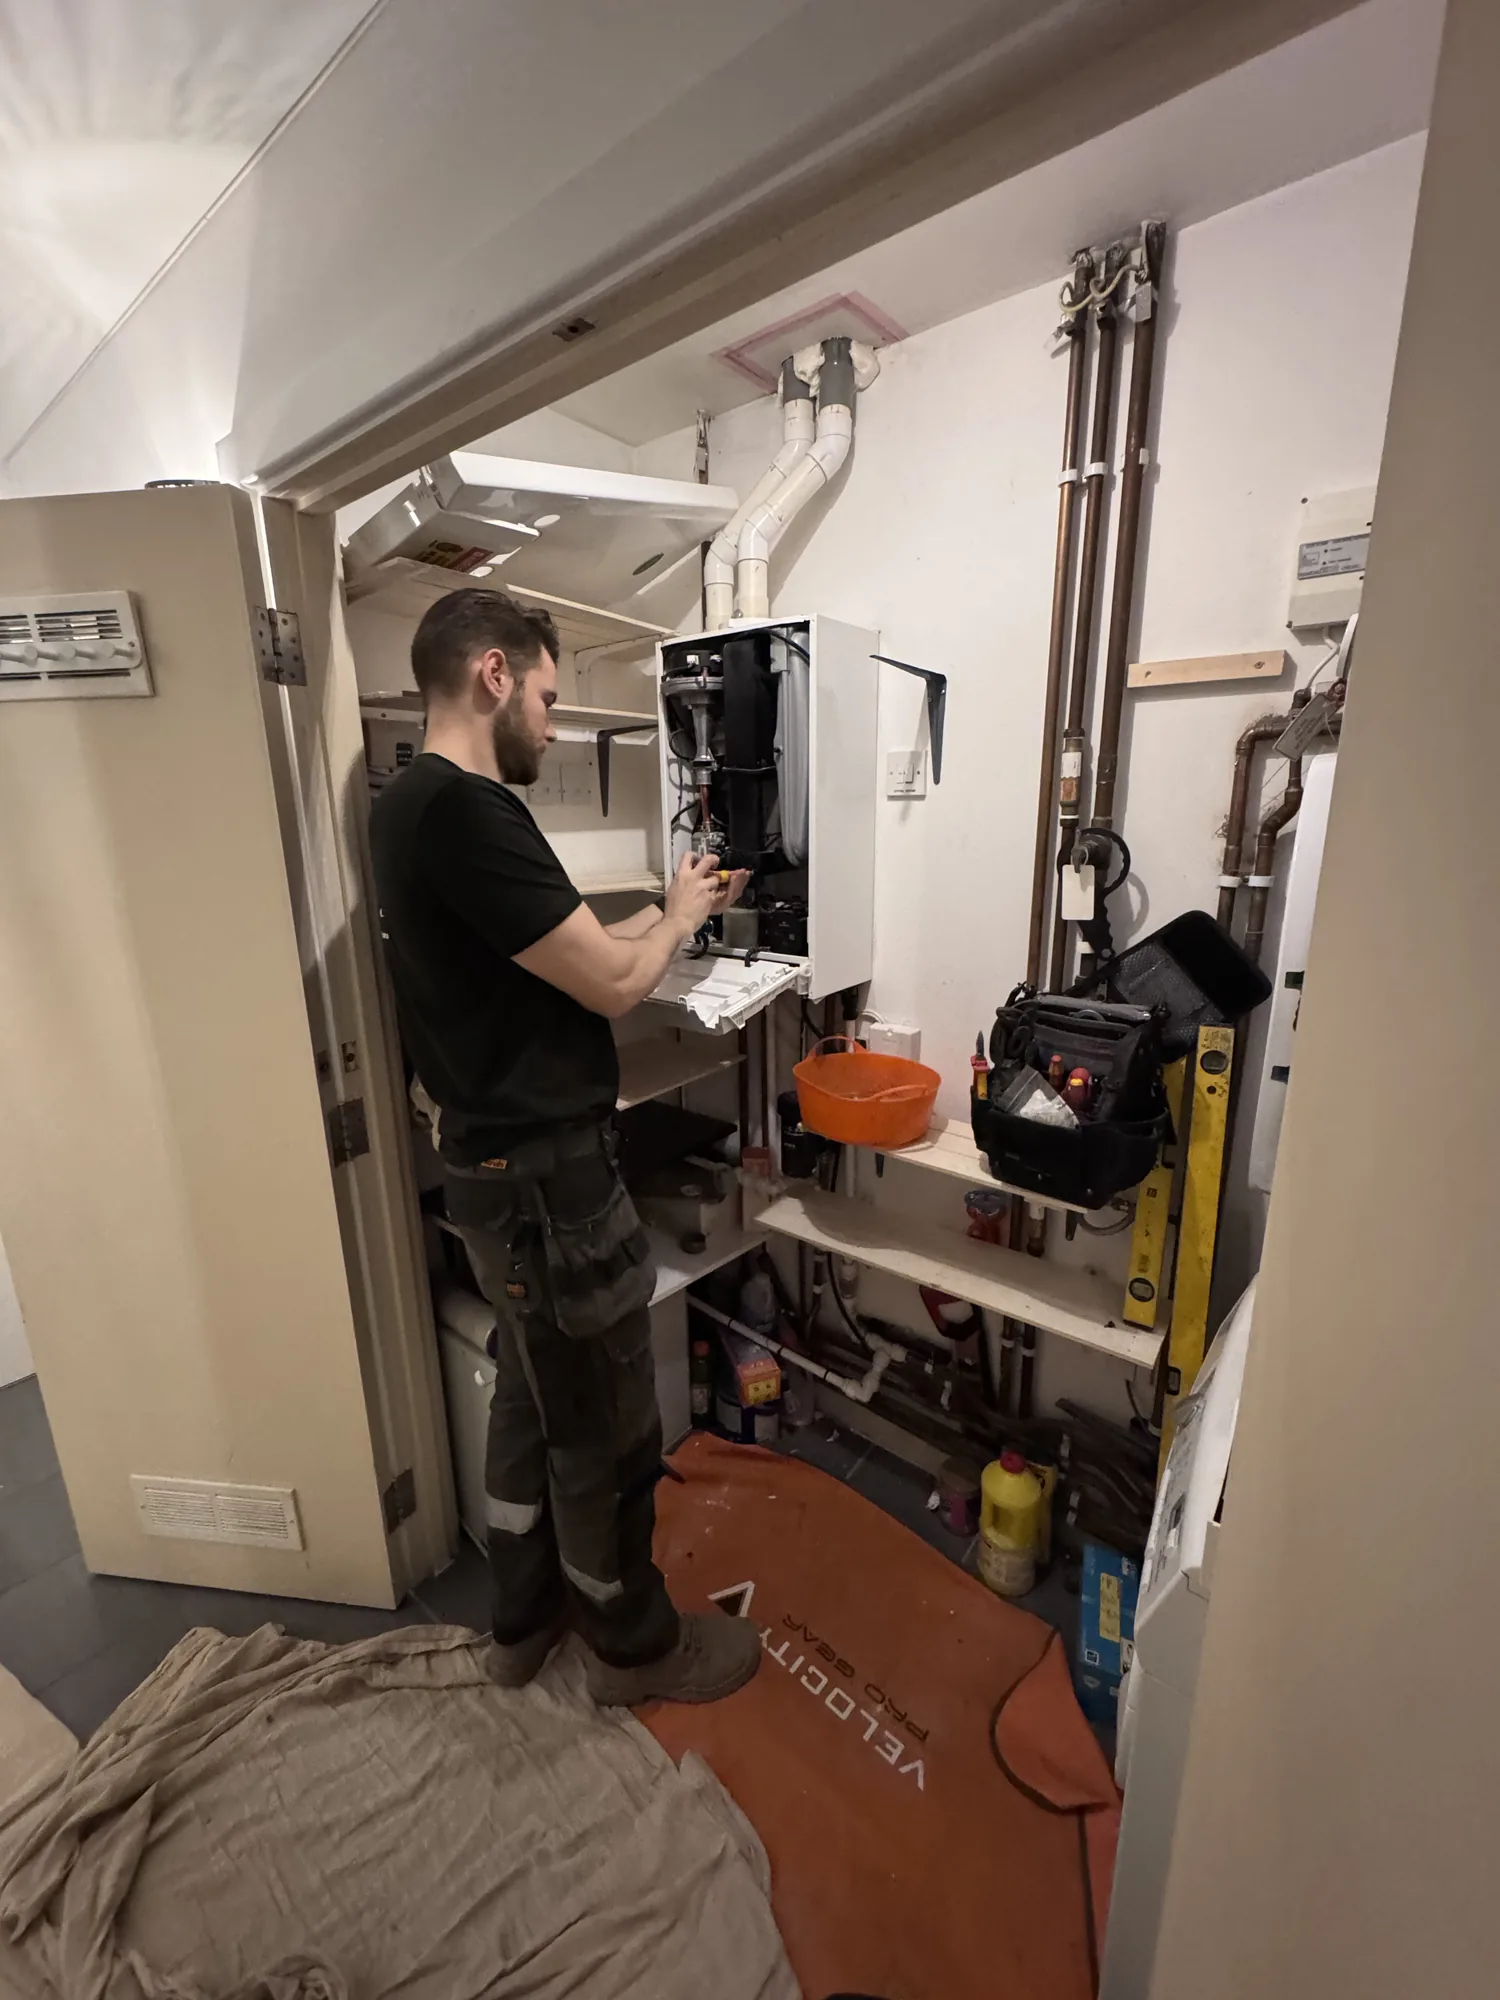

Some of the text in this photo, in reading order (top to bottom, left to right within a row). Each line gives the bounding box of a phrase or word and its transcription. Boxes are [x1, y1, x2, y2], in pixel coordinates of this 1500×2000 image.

[759, 1627, 925, 1791] VELOCITY
[782, 1613, 930, 1742] PRO GEAR
